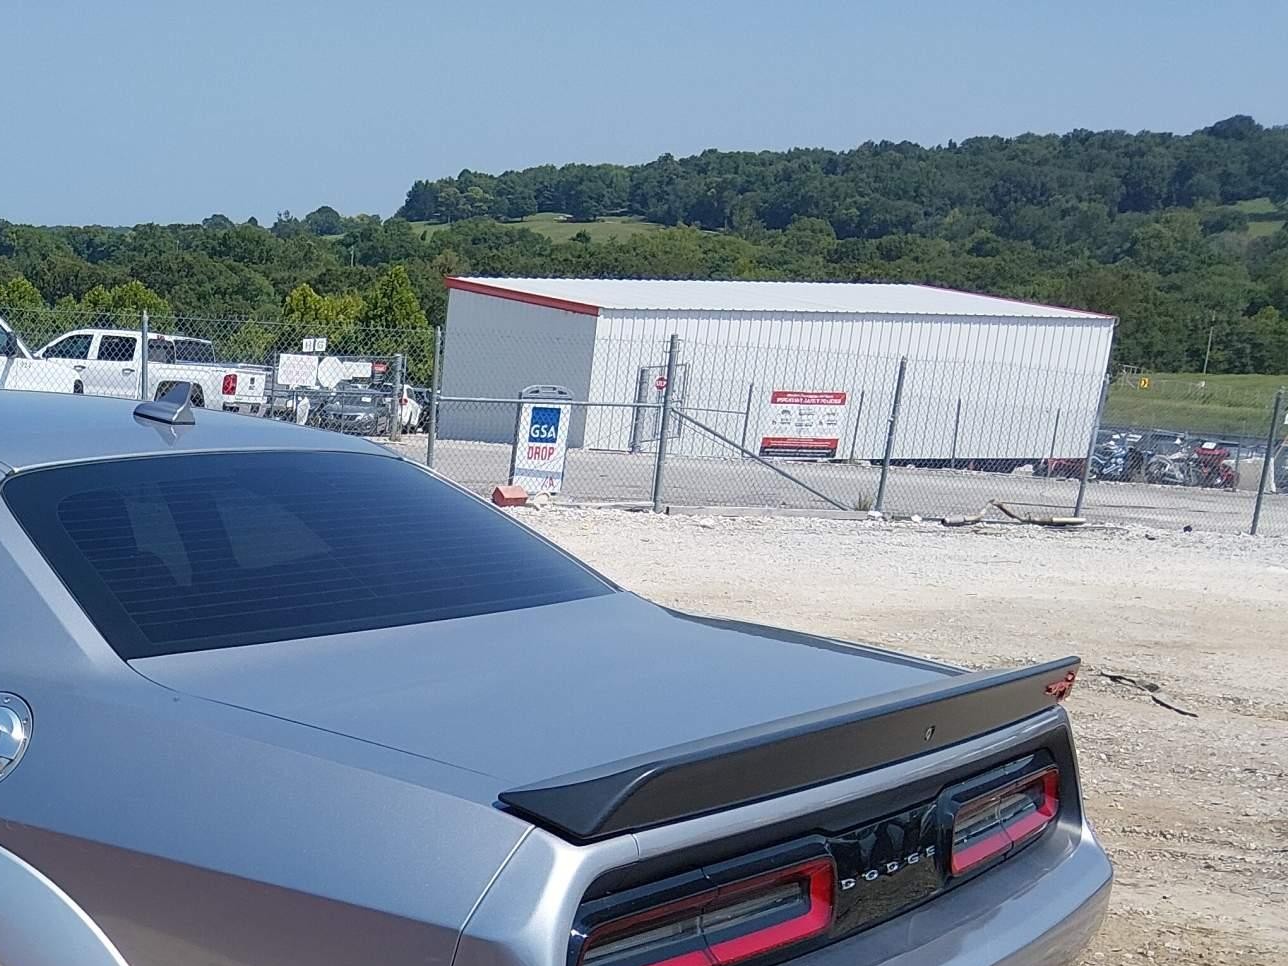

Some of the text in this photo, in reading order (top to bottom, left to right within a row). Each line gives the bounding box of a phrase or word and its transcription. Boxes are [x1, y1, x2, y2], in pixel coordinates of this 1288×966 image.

[531, 424, 556, 438] GSA
[527, 446, 554, 460] DROP
[841, 845, 935, 890] DODGE
